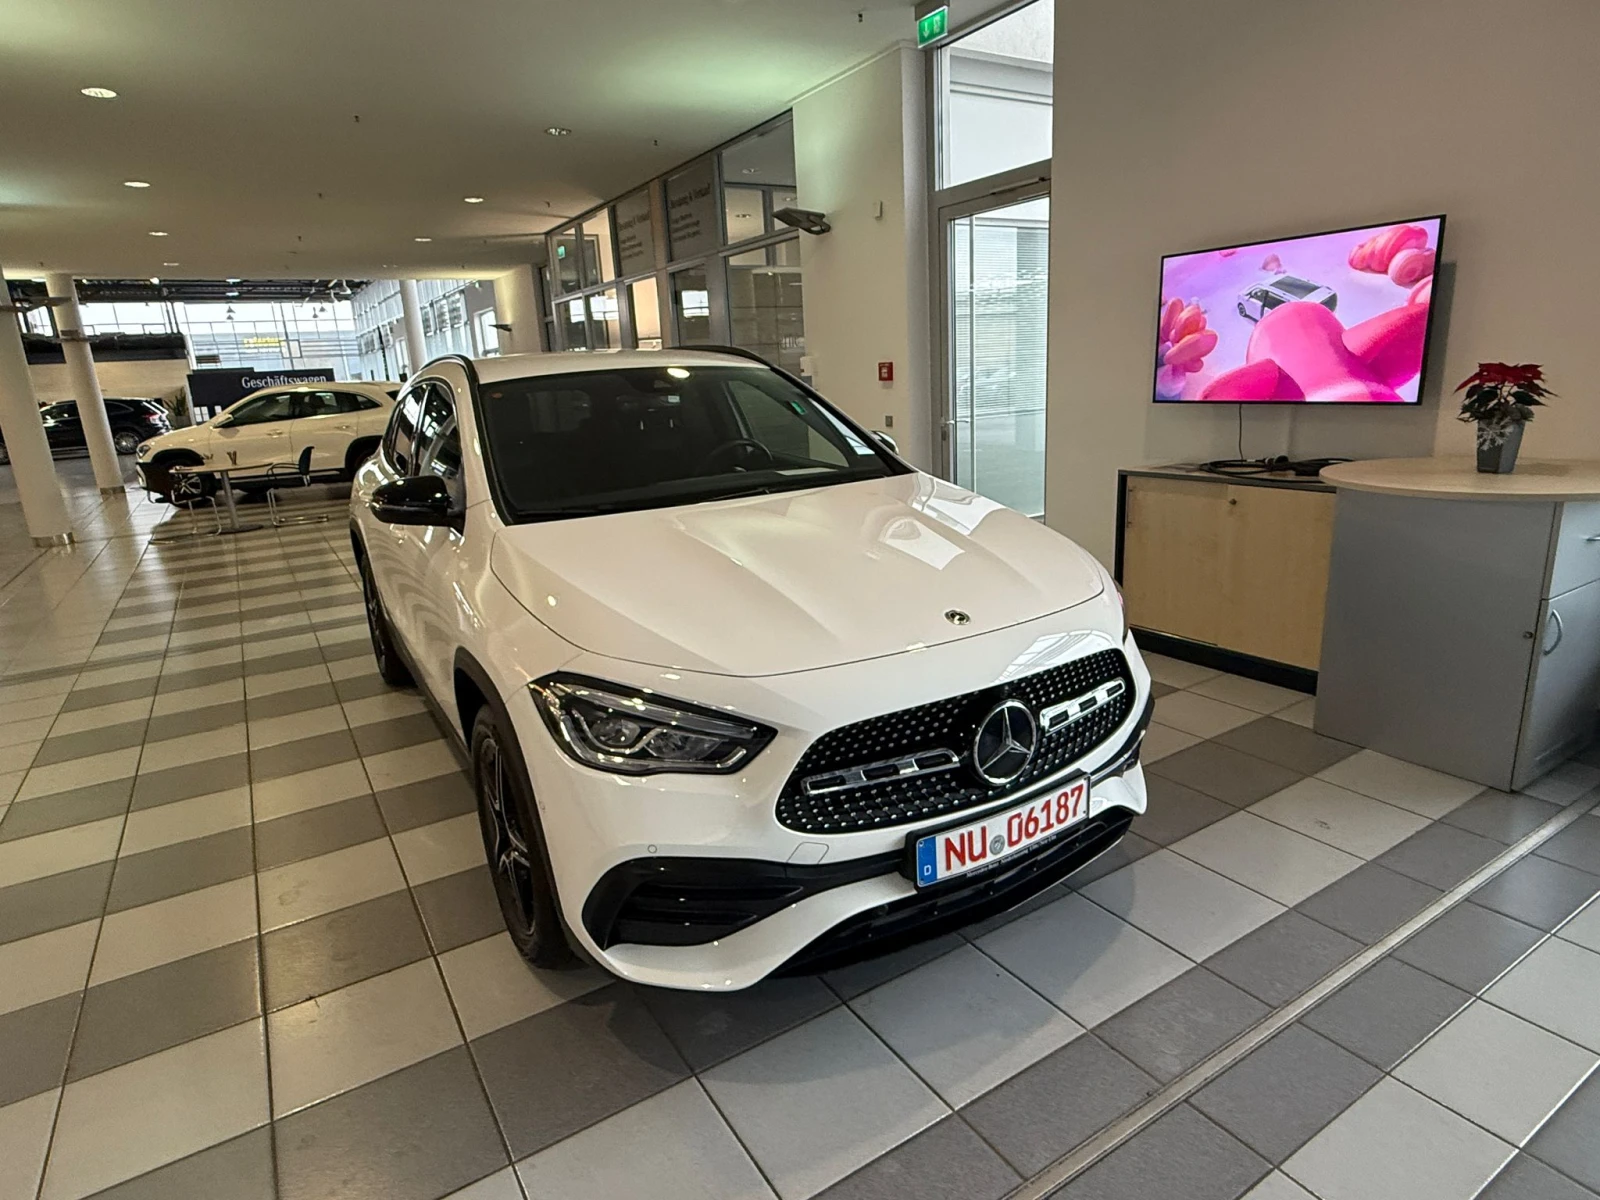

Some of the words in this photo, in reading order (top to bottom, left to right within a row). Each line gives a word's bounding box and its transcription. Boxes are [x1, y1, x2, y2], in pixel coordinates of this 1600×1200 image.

[945, 826, 987, 871] NU
[1007, 783, 1084, 848] 06187
[924, 865, 932, 875] D
